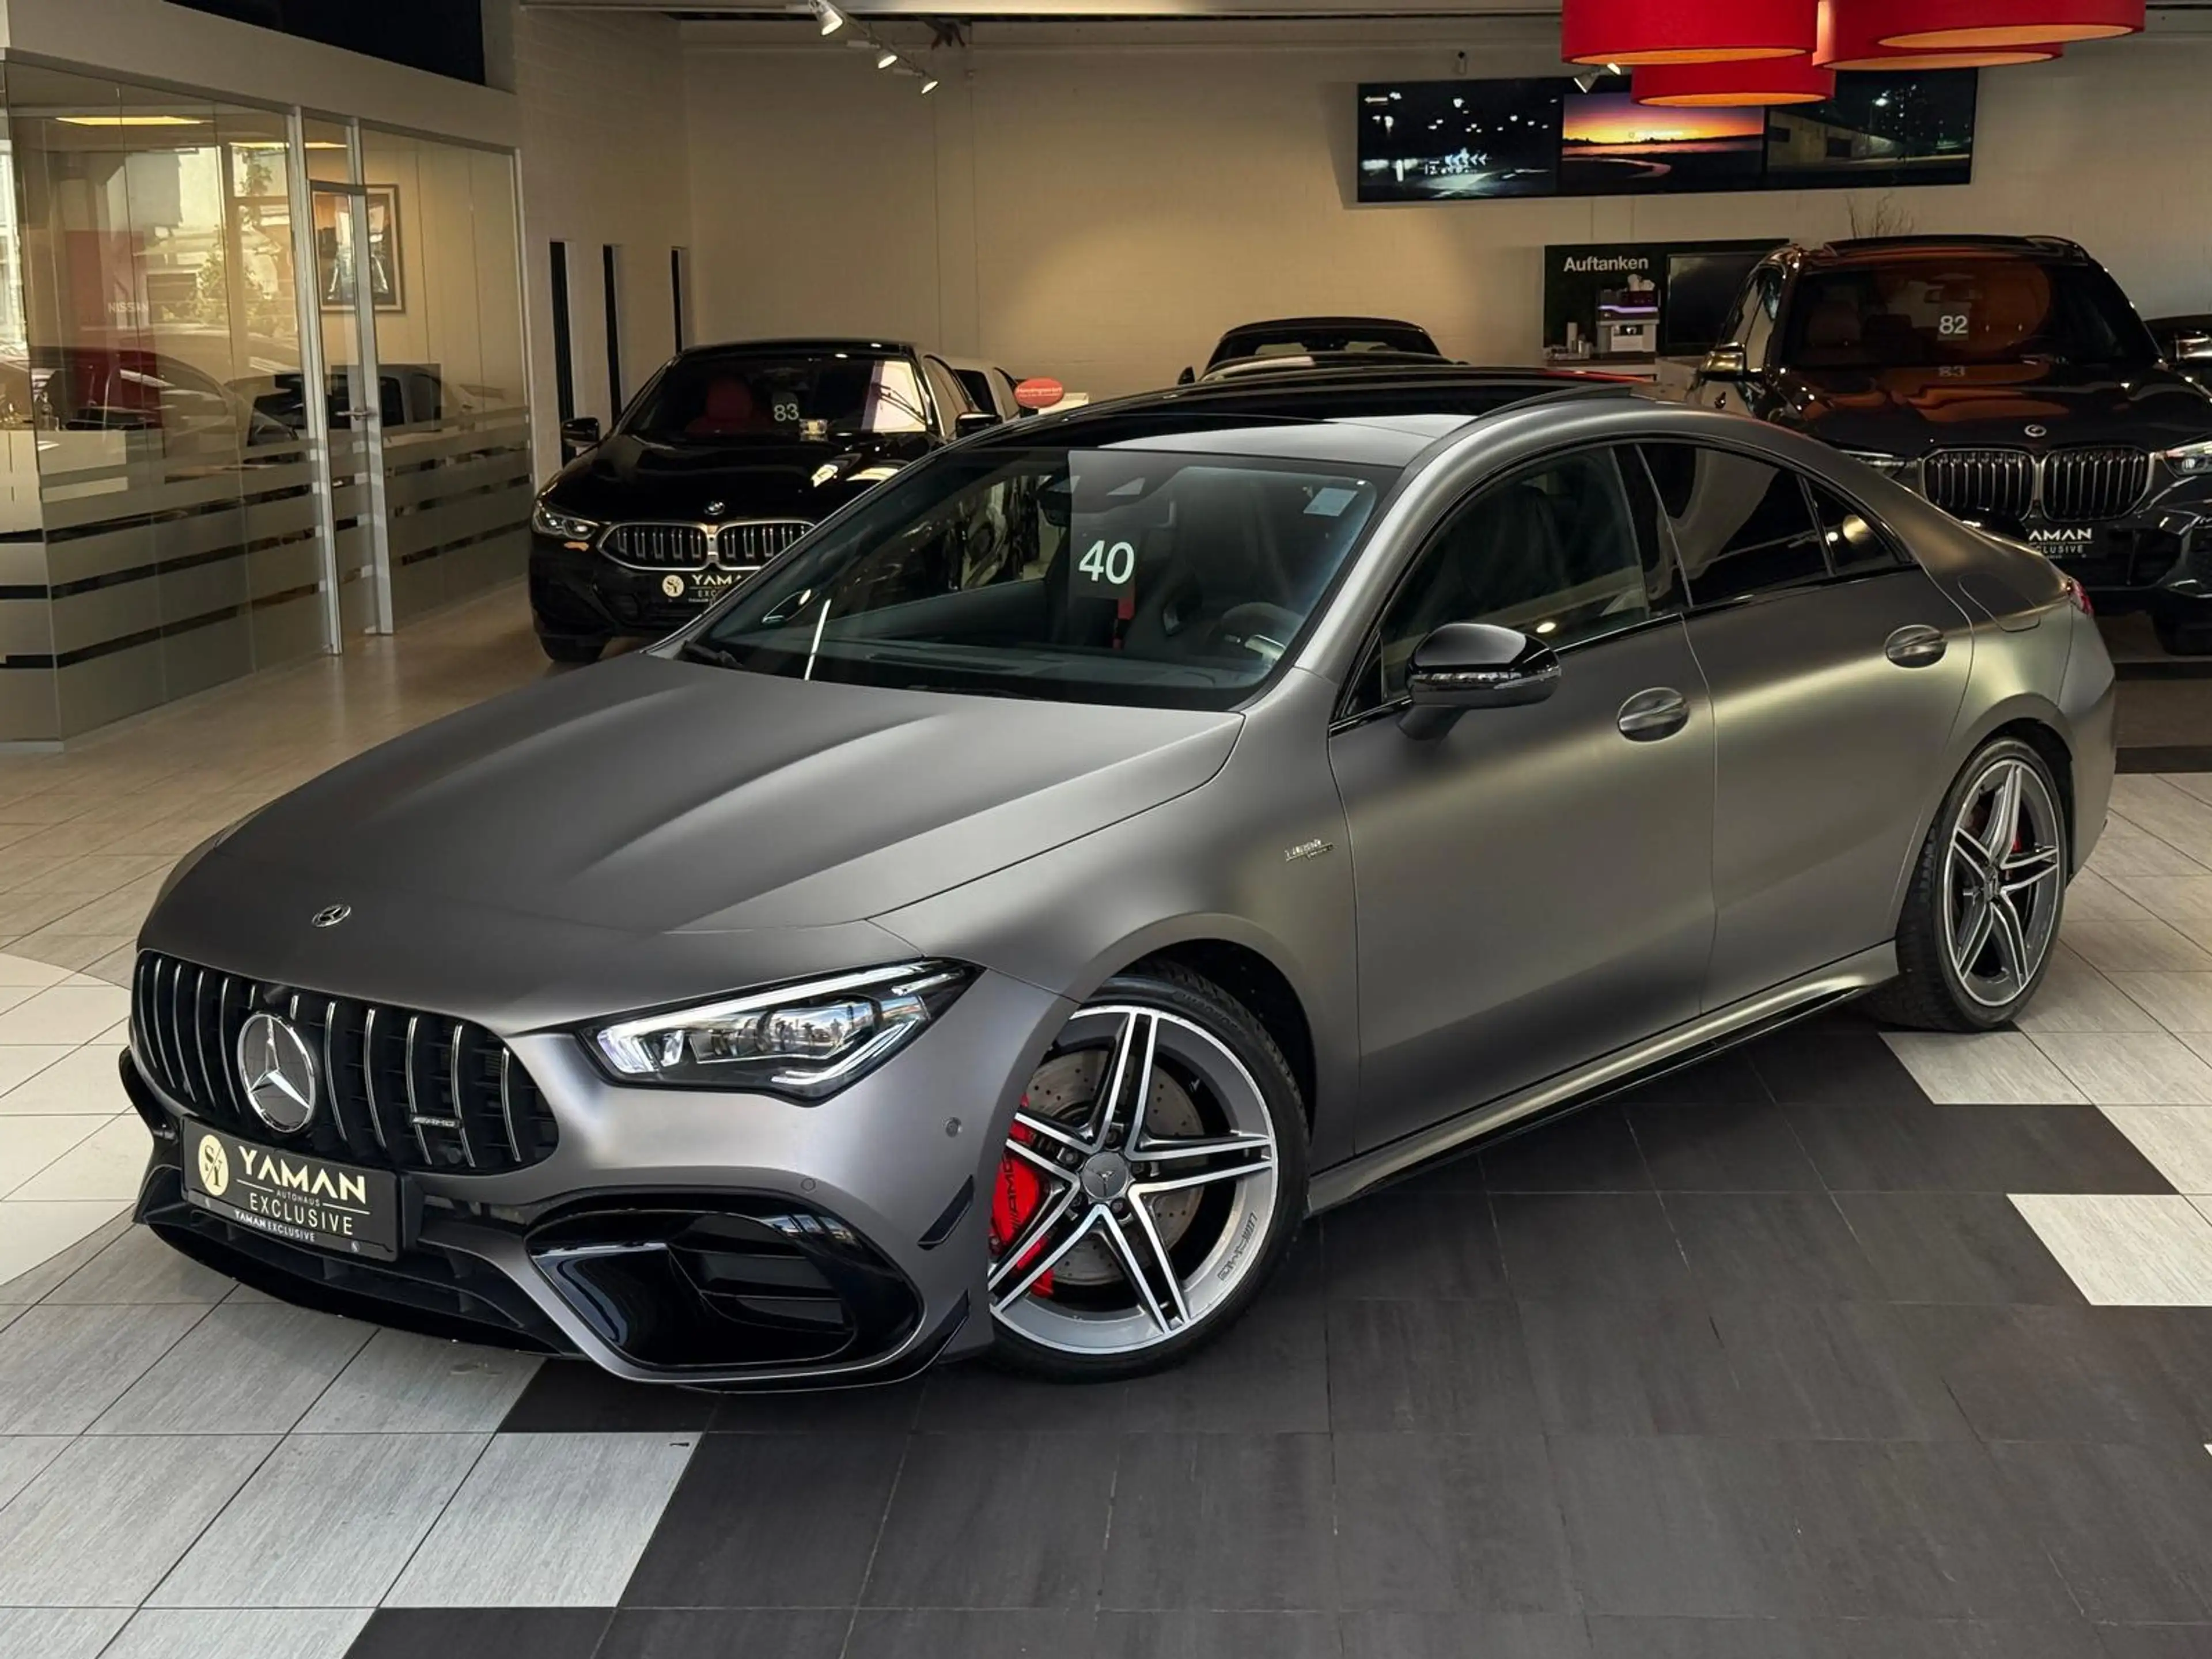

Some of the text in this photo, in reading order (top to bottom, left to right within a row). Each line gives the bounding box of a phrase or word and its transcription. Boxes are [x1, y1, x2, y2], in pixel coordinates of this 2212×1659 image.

[1563, 256, 1649, 272] Auftanken
[1939, 315, 1968, 334] 82
[774, 404, 799, 422] 83
[2029, 528, 2092, 541] AMAN
[1078, 540, 1135, 585] 40
[692, 574, 742, 585] YAM
[238, 1145, 367, 1205] YAMAN
[276, 1189, 320, 1207] AUTOHAUS
[249, 1192, 354, 1236] EXCLUSIVE
[234, 1209, 315, 1242] YAMAN EXCLUSIVE
